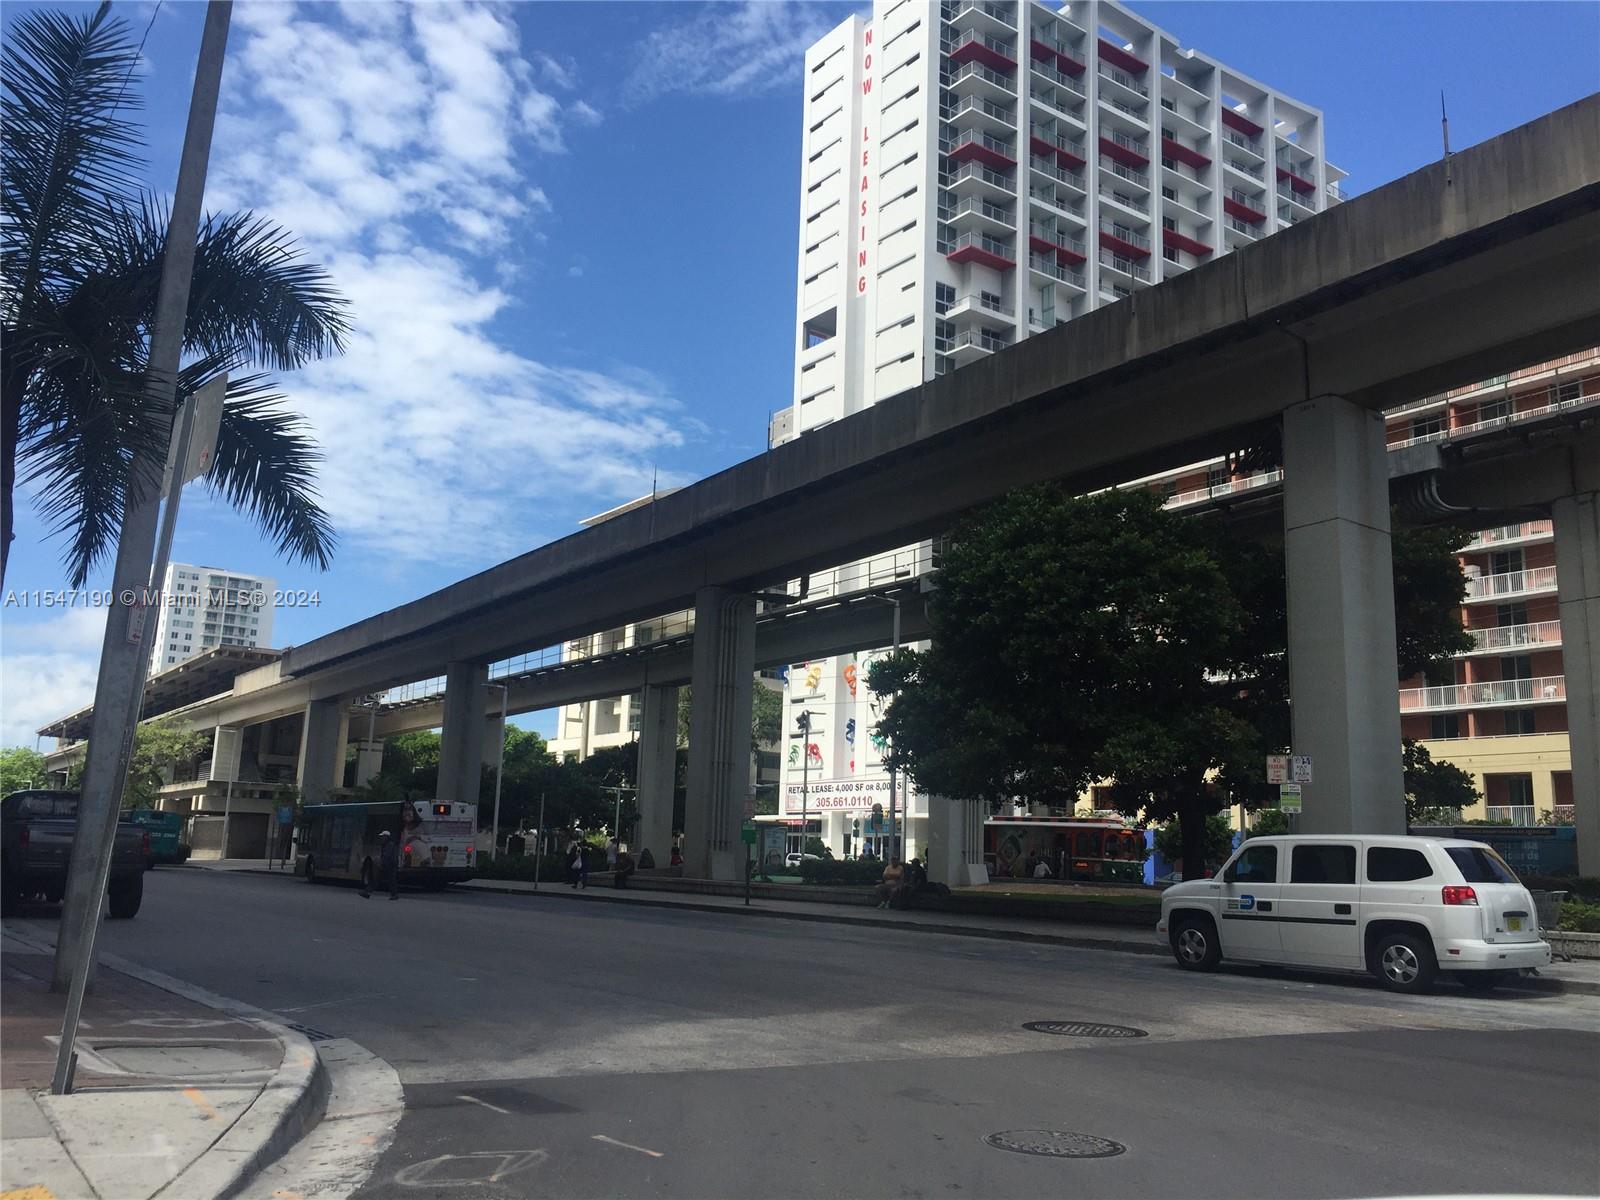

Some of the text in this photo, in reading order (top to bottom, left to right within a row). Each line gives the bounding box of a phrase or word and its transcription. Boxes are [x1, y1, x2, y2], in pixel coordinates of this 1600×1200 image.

[857, 29, 873, 293] NOW LEASING
[788, 786, 809, 794] RETAL
[811, 784, 834, 793] LEASE:
[835, 784, 854, 792] 4,000
[855, 783, 864, 791] SF
[875, 782, 891, 791] 8,00
[815, 795, 873, 808] 305.661.0110
